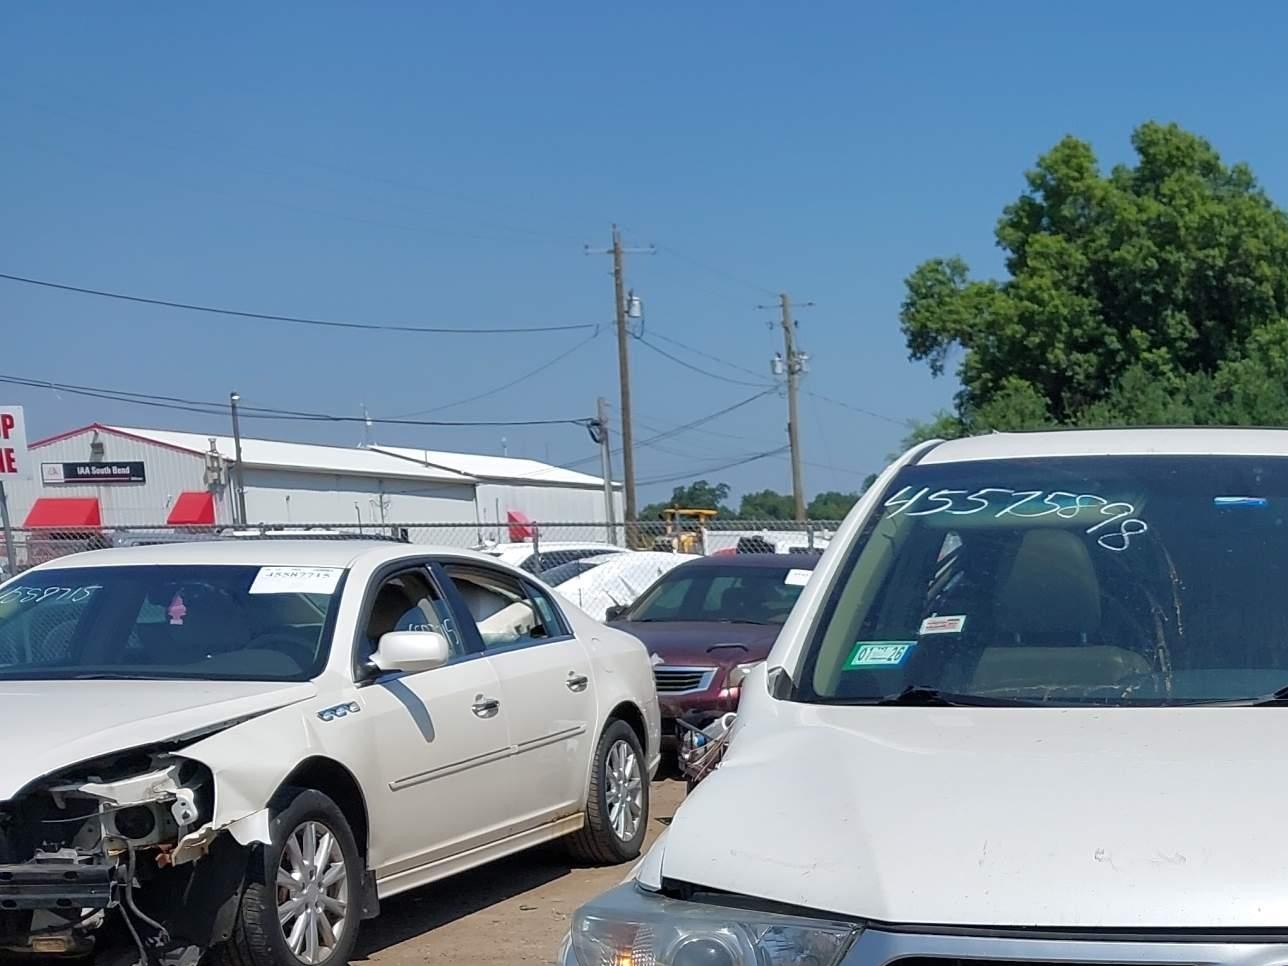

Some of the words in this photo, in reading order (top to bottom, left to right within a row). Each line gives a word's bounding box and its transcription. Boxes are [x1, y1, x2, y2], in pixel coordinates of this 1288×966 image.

[0, 413, 15, 439] P
[91, 466, 111, 475] South
[112, 466, 130, 475] Bend
